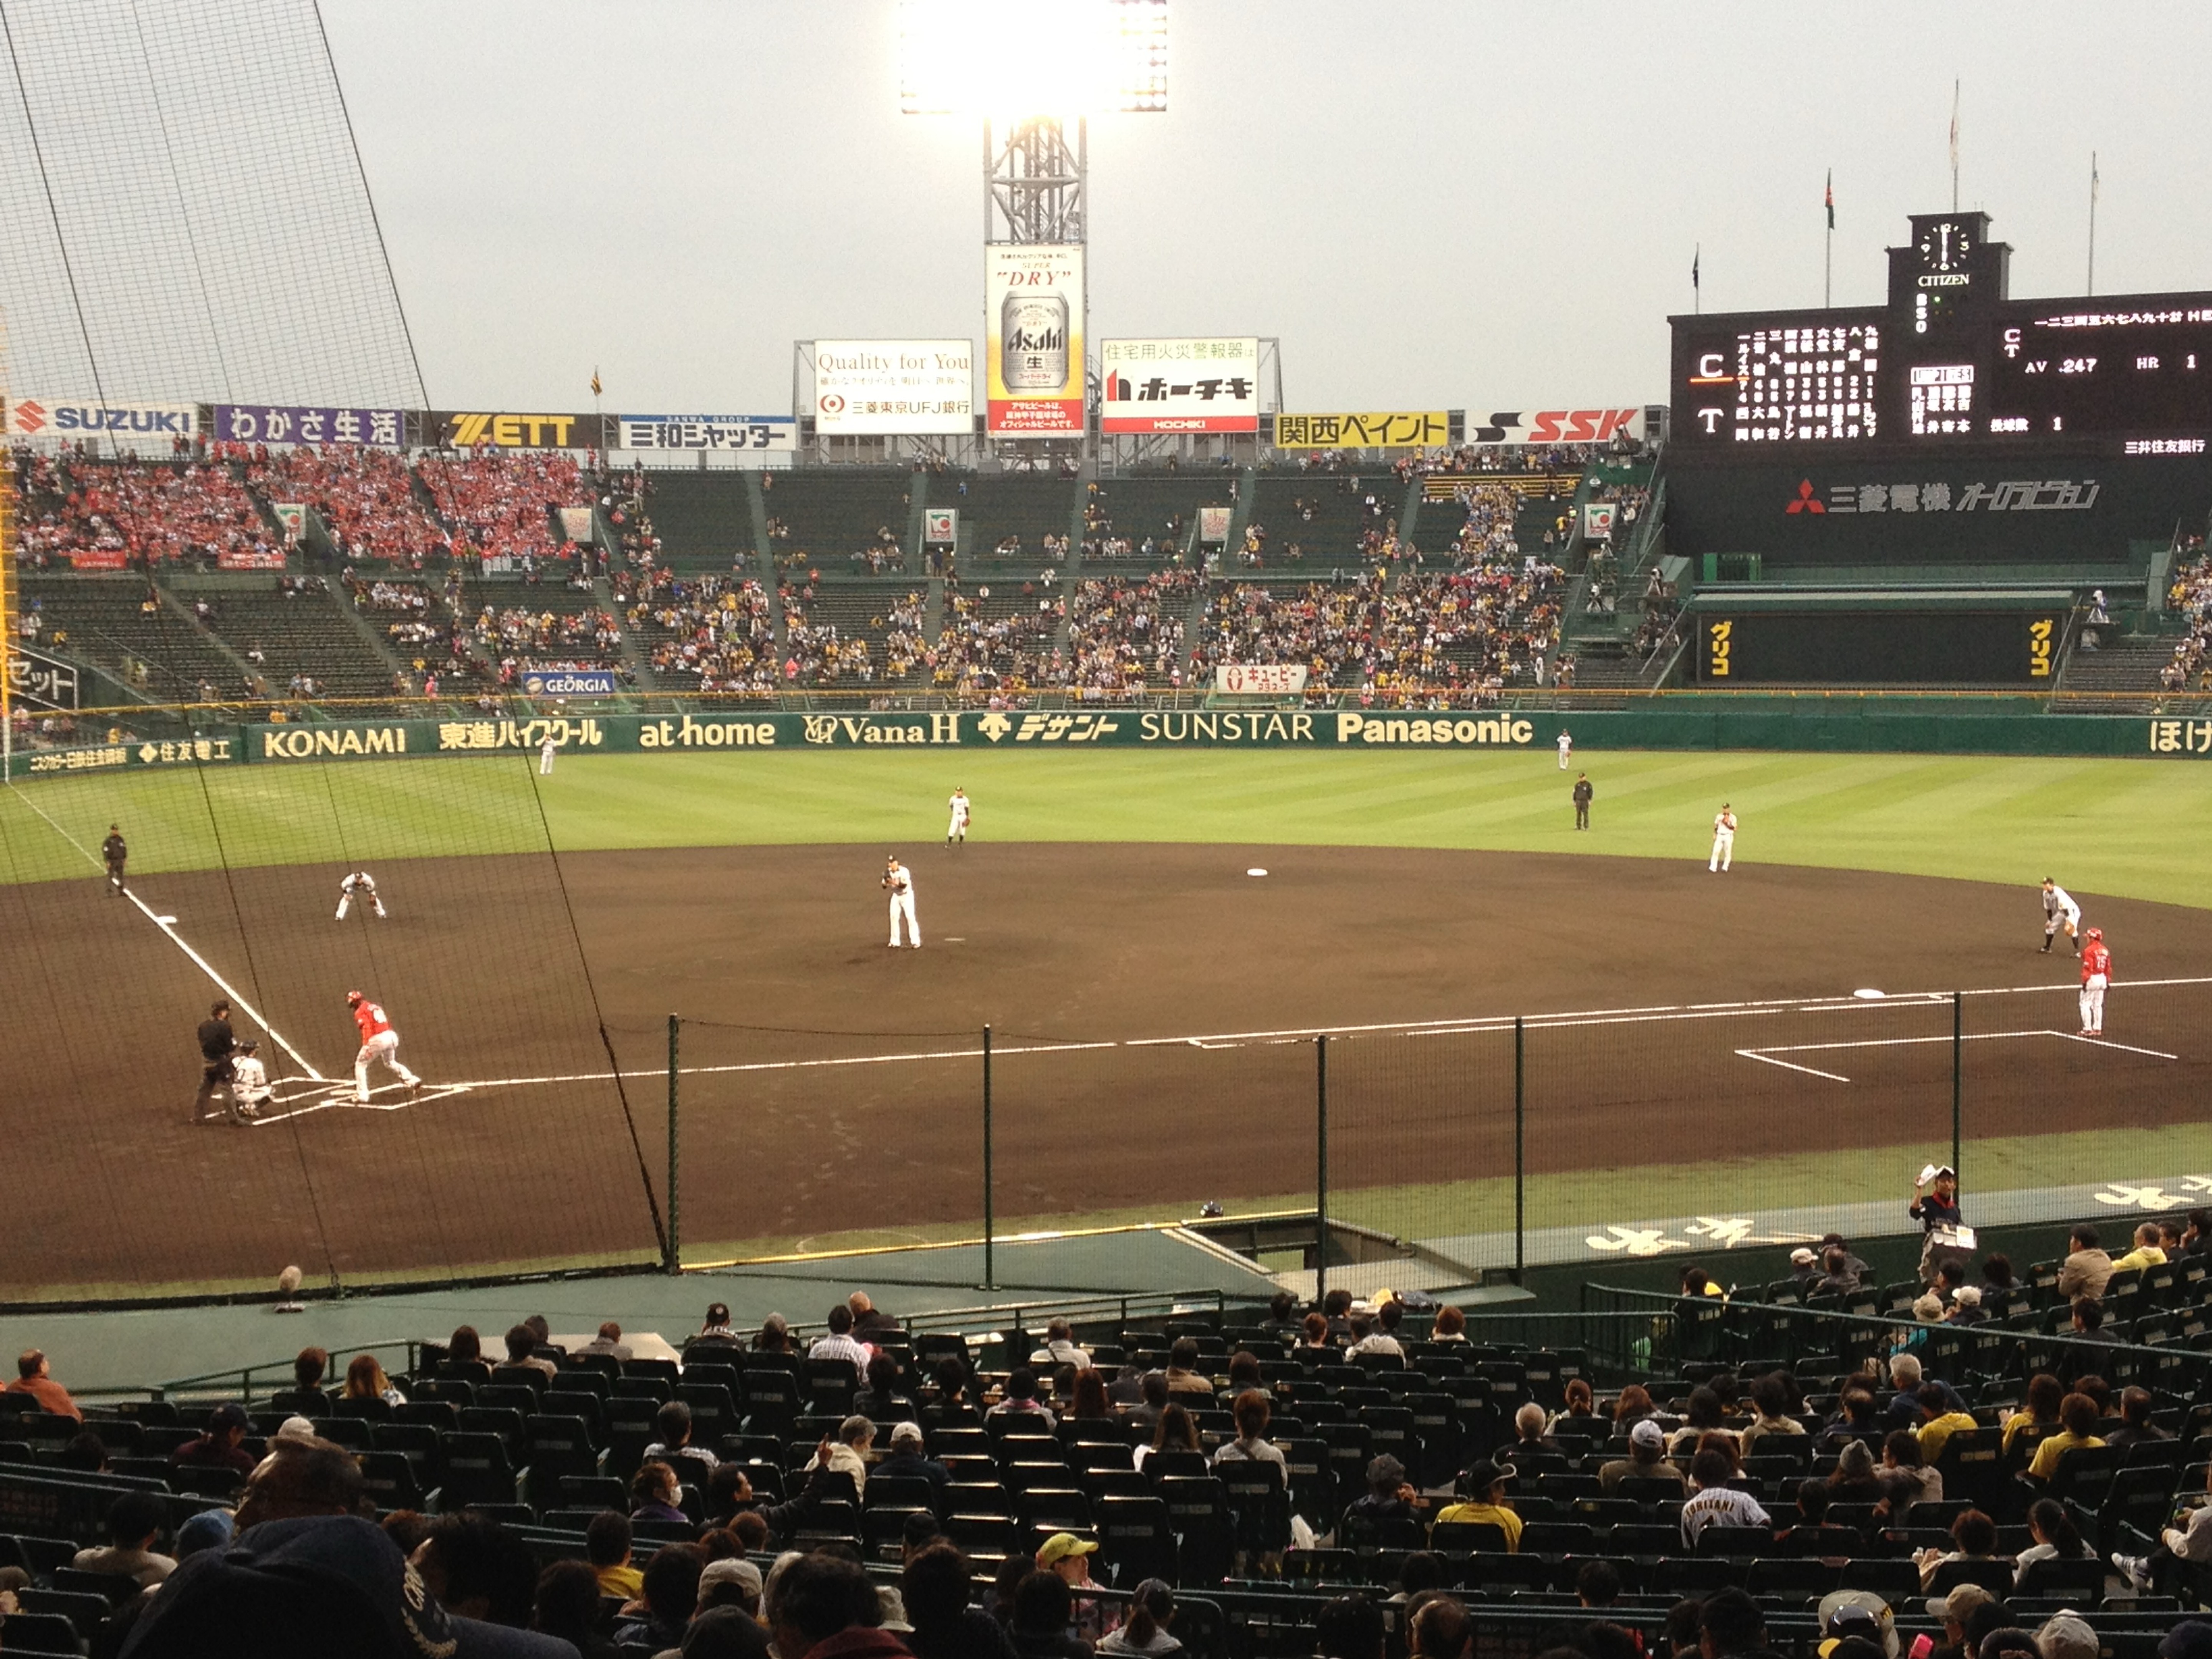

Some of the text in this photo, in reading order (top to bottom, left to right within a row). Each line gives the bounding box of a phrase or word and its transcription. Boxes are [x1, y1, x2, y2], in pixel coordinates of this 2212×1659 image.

[1921, 241, 1970, 253] 9 3
[1918, 274, 1970, 287] CITIZEN
[1916, 307, 1927, 319] S
[2188, 310, 2200, 321] H
[1007, 326, 1062, 351] Asahi
[1770, 331, 1782, 340] 三
[1818, 329, 1829, 338] 六
[1850, 327, 1861, 335] 八
[2004, 329, 2021, 343] C
[1106, 343, 1255, 360] 住宅用火災警報器は
[2004, 343, 2020, 358] T
[819, 353, 969, 373] Quality for You
[1027, 356, 1043, 369] 生
[1700, 354, 1724, 377] C
[2025, 355, 2196, 374] AV .247 HR 1
[1137, 377, 1253, 401] ホーチキ
[1755, 380, 1762, 389] 4
[1851, 376, 1858, 386] 2
[1868, 376, 1873, 385] 1
[1739, 393, 1747, 402] 4
[1786, 391, 1794, 401] 7
[1851, 389, 1858, 399] 2
[1868, 389, 1872, 398] 1
[852, 400, 970, 414] 三菱東京UFJ銀行
[55, 407, 189, 432] SUZUKI
[231, 408, 396, 444] わかさ生活
[451, 414, 575, 446] ZETT
[1154, 420, 1205, 429] HOCHIKI
[1279, 414, 1445, 444] 関西ペイント
[1527, 409, 1638, 441] SSK
[1697, 408, 1724, 433] T
[2053, 417, 2062, 430] 1
[631, 423, 786, 448] 三和シャッター
[2124, 440, 2205, 454] 三井住友銀行
[1828, 482, 1950, 513] 三菱電機
[1710, 620, 1733, 676] グリコ
[2029, 619, 2053, 676] グリコ
[439, 719, 602, 749] 東進ハイスクール
[639, 715, 775, 747] at home
[1015, 713, 1118, 741] デサント
[1140, 713, 1315, 741] SUNSTAR
[1337, 713, 1533, 743] Panasonic
[160, 740, 230, 762] 住友電工
[264, 728, 406, 757] KONAMI
[1685, 1498, 1735, 1518] TORITANI
